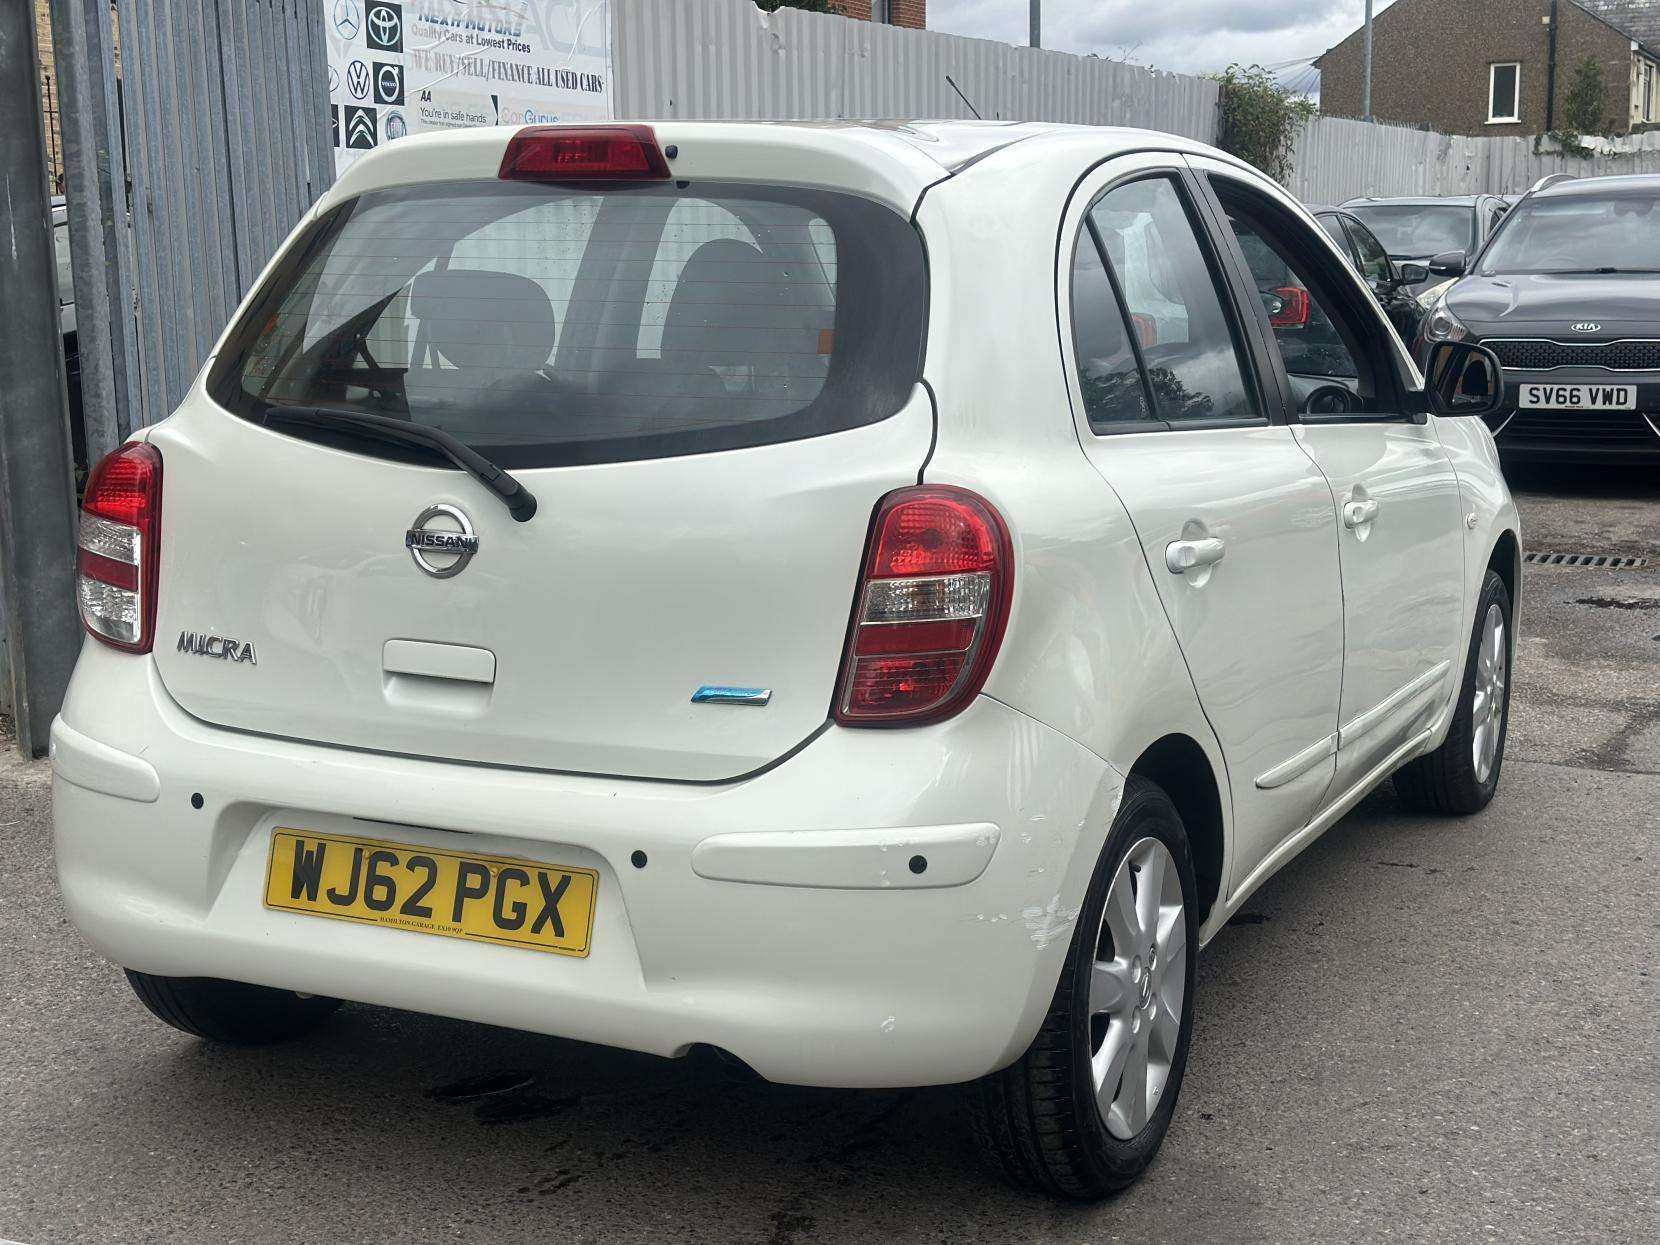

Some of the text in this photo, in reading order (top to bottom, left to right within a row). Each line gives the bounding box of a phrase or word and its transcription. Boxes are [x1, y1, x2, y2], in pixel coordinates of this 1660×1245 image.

[411, 24, 531, 53] Quality Cars at Lowest Prices
[535, 67, 552, 86] ALL
[555, 69, 577, 90] USED
[420, 90, 431, 102] AA
[420, 107, 486, 123] You're in safe hands
[1529, 387, 1628, 405] SV66 VWD
[410, 532, 473, 551] NISSAN
[177, 631, 257, 665] MICRA
[290, 840, 572, 938] WJ62 PGX
